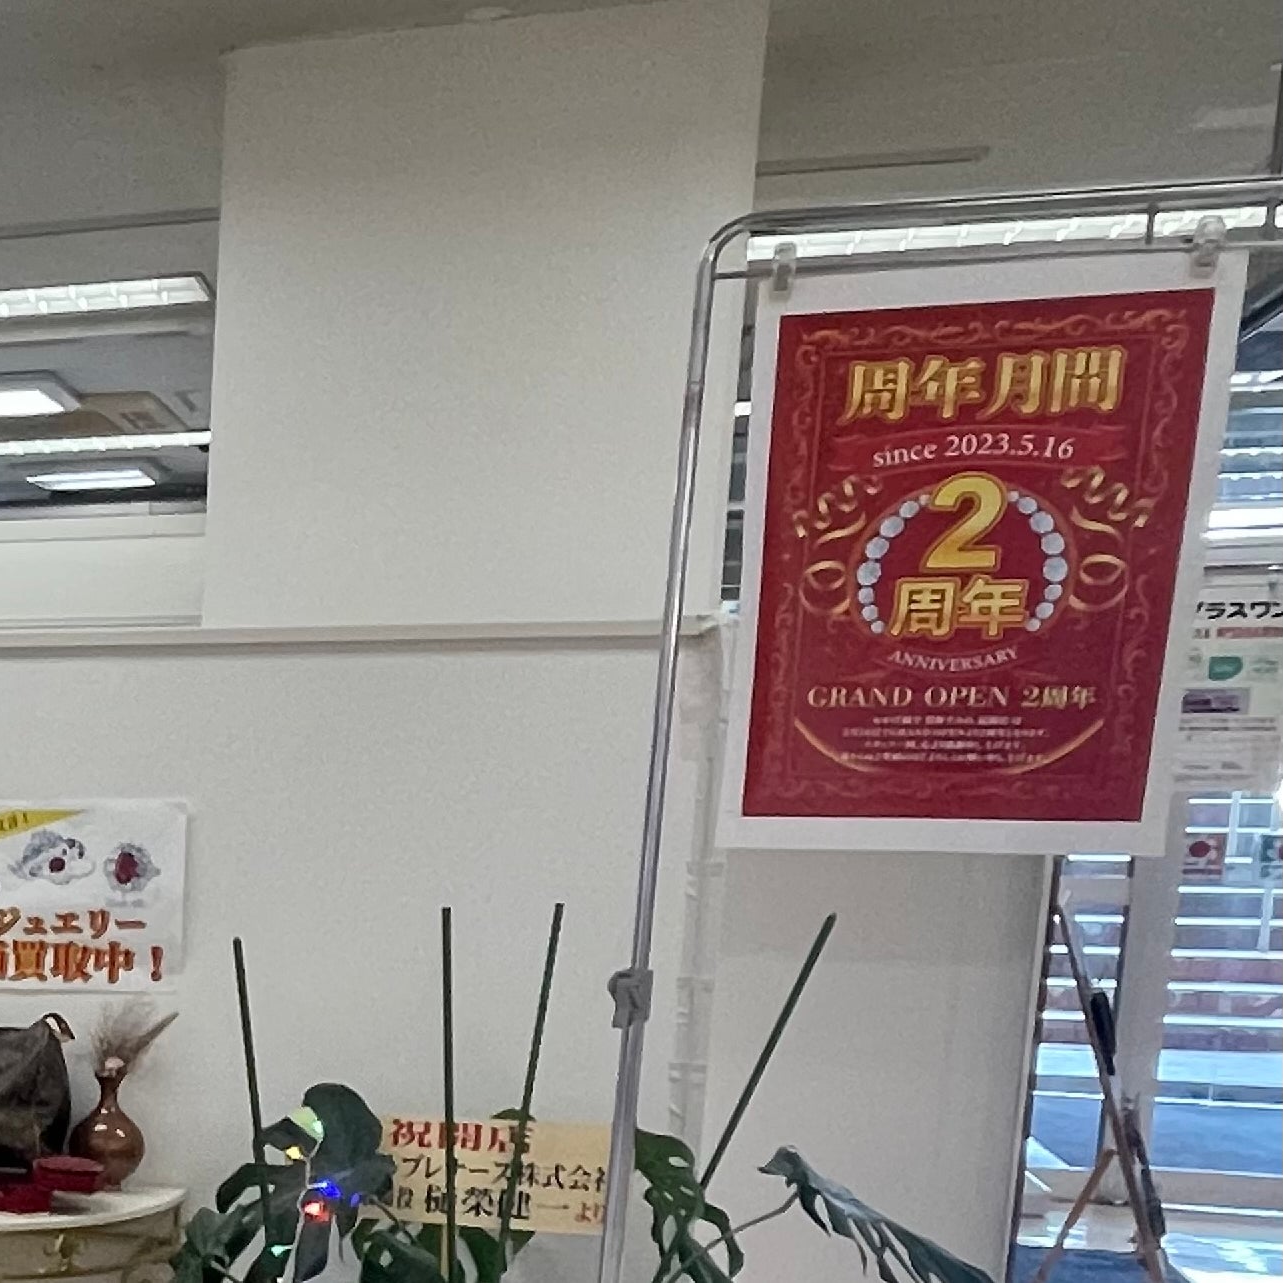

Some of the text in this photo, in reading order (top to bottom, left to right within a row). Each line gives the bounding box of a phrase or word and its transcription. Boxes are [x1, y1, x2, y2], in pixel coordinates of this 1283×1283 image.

[838, 345, 1128, 421] 周年月間
[873, 432, 1075, 467] since 2023.5.16
[920, 471, 1007, 572] 2
[889, 575, 1030, 640] 周年
[888, 648, 1018, 671] ANNIVERSARY
[807, 686, 912, 708] GRAND
[924, 686, 1009, 707] OPEN
